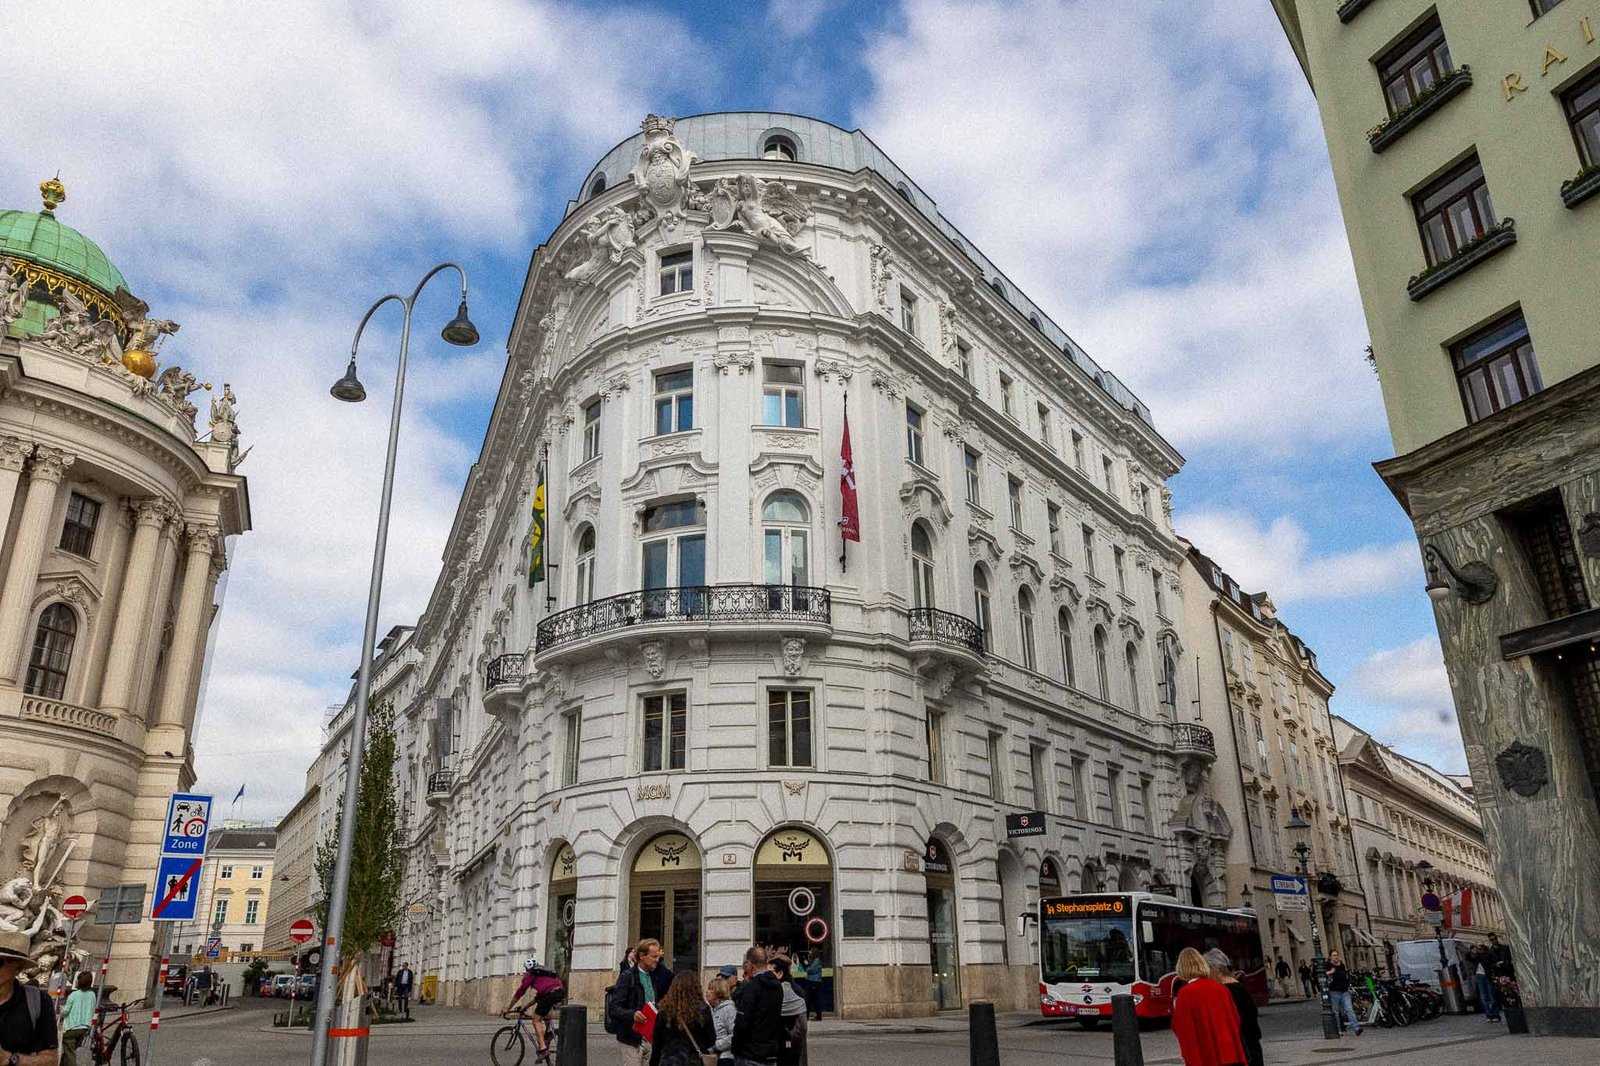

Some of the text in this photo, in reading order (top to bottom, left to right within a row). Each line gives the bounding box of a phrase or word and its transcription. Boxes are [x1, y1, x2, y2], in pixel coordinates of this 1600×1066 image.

[637, 784, 671, 801] MCM
[190, 823, 203, 835] 20
[1008, 827, 1043, 835] VICTORINOX
[171, 838, 198, 849] Zone
[1056, 902, 1112, 912] Stephansplatz
